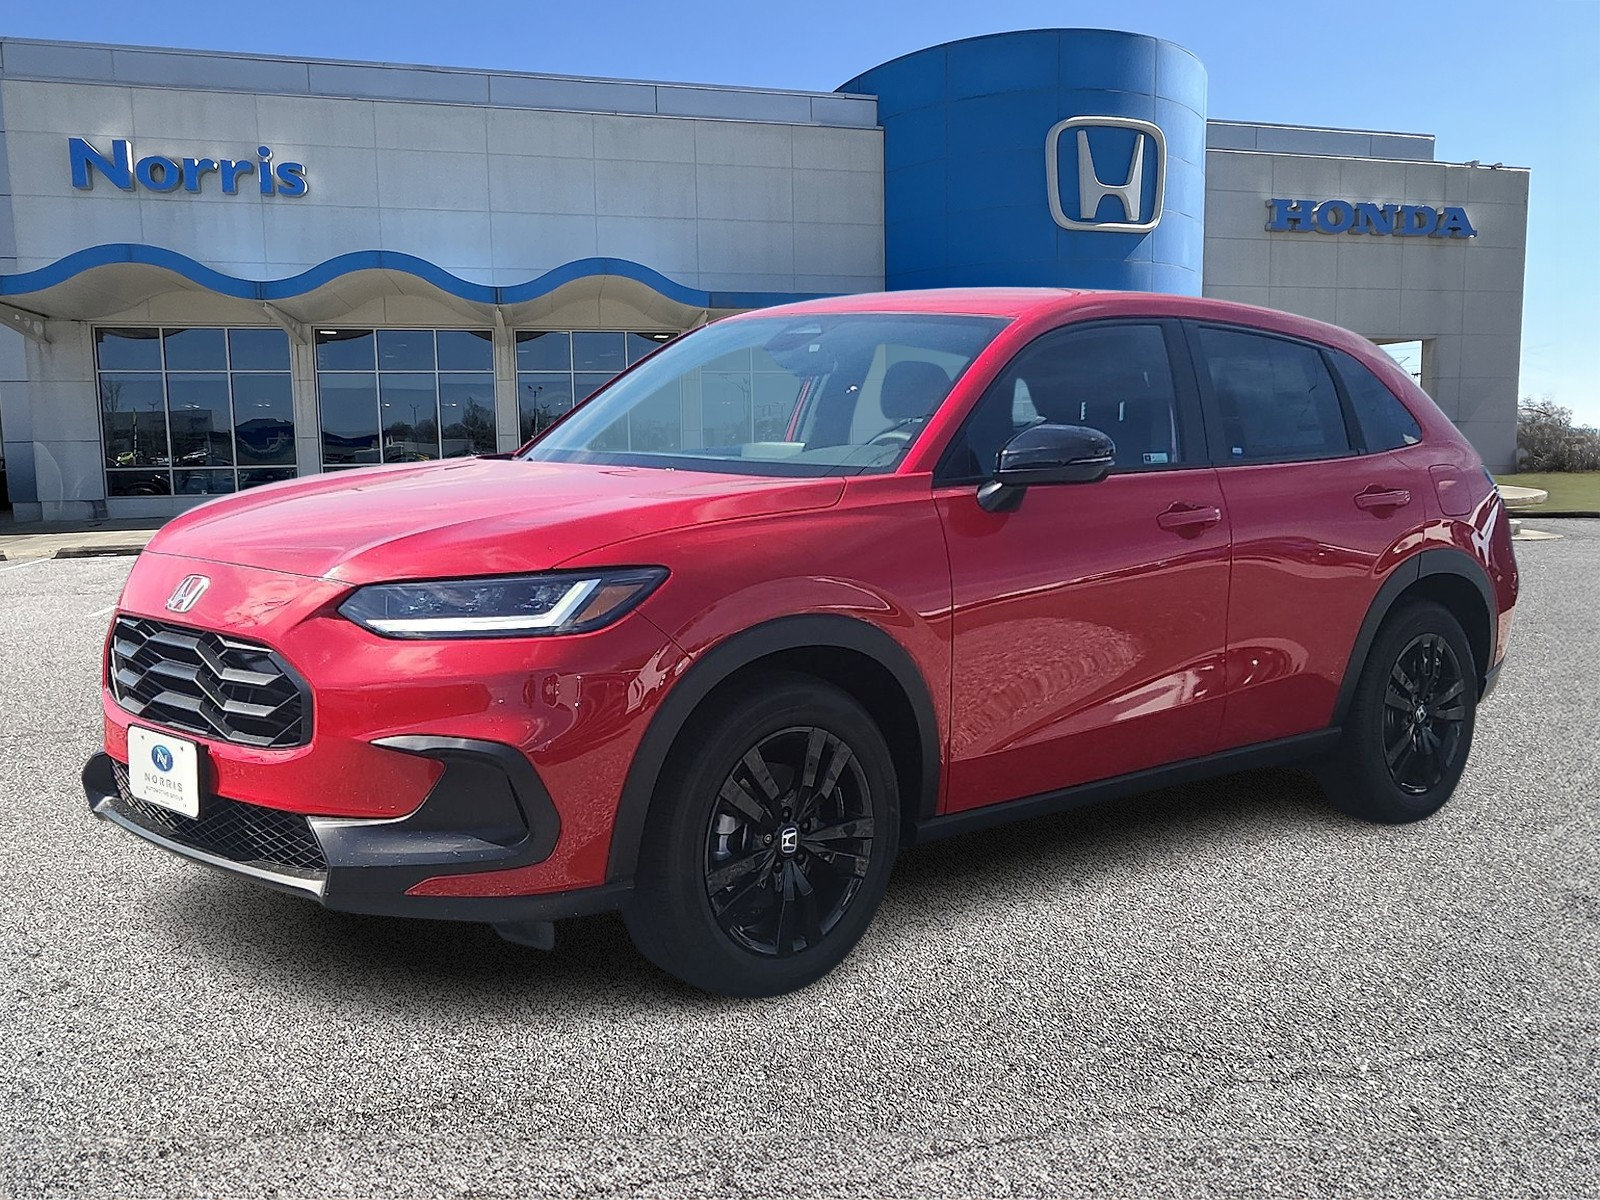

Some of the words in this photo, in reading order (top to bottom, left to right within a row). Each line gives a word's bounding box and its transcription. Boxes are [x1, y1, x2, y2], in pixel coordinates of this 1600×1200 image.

[68, 137, 309, 197] Norris
[1265, 198, 1478, 239] HONDA
[144, 772, 183, 793] NORRIS
